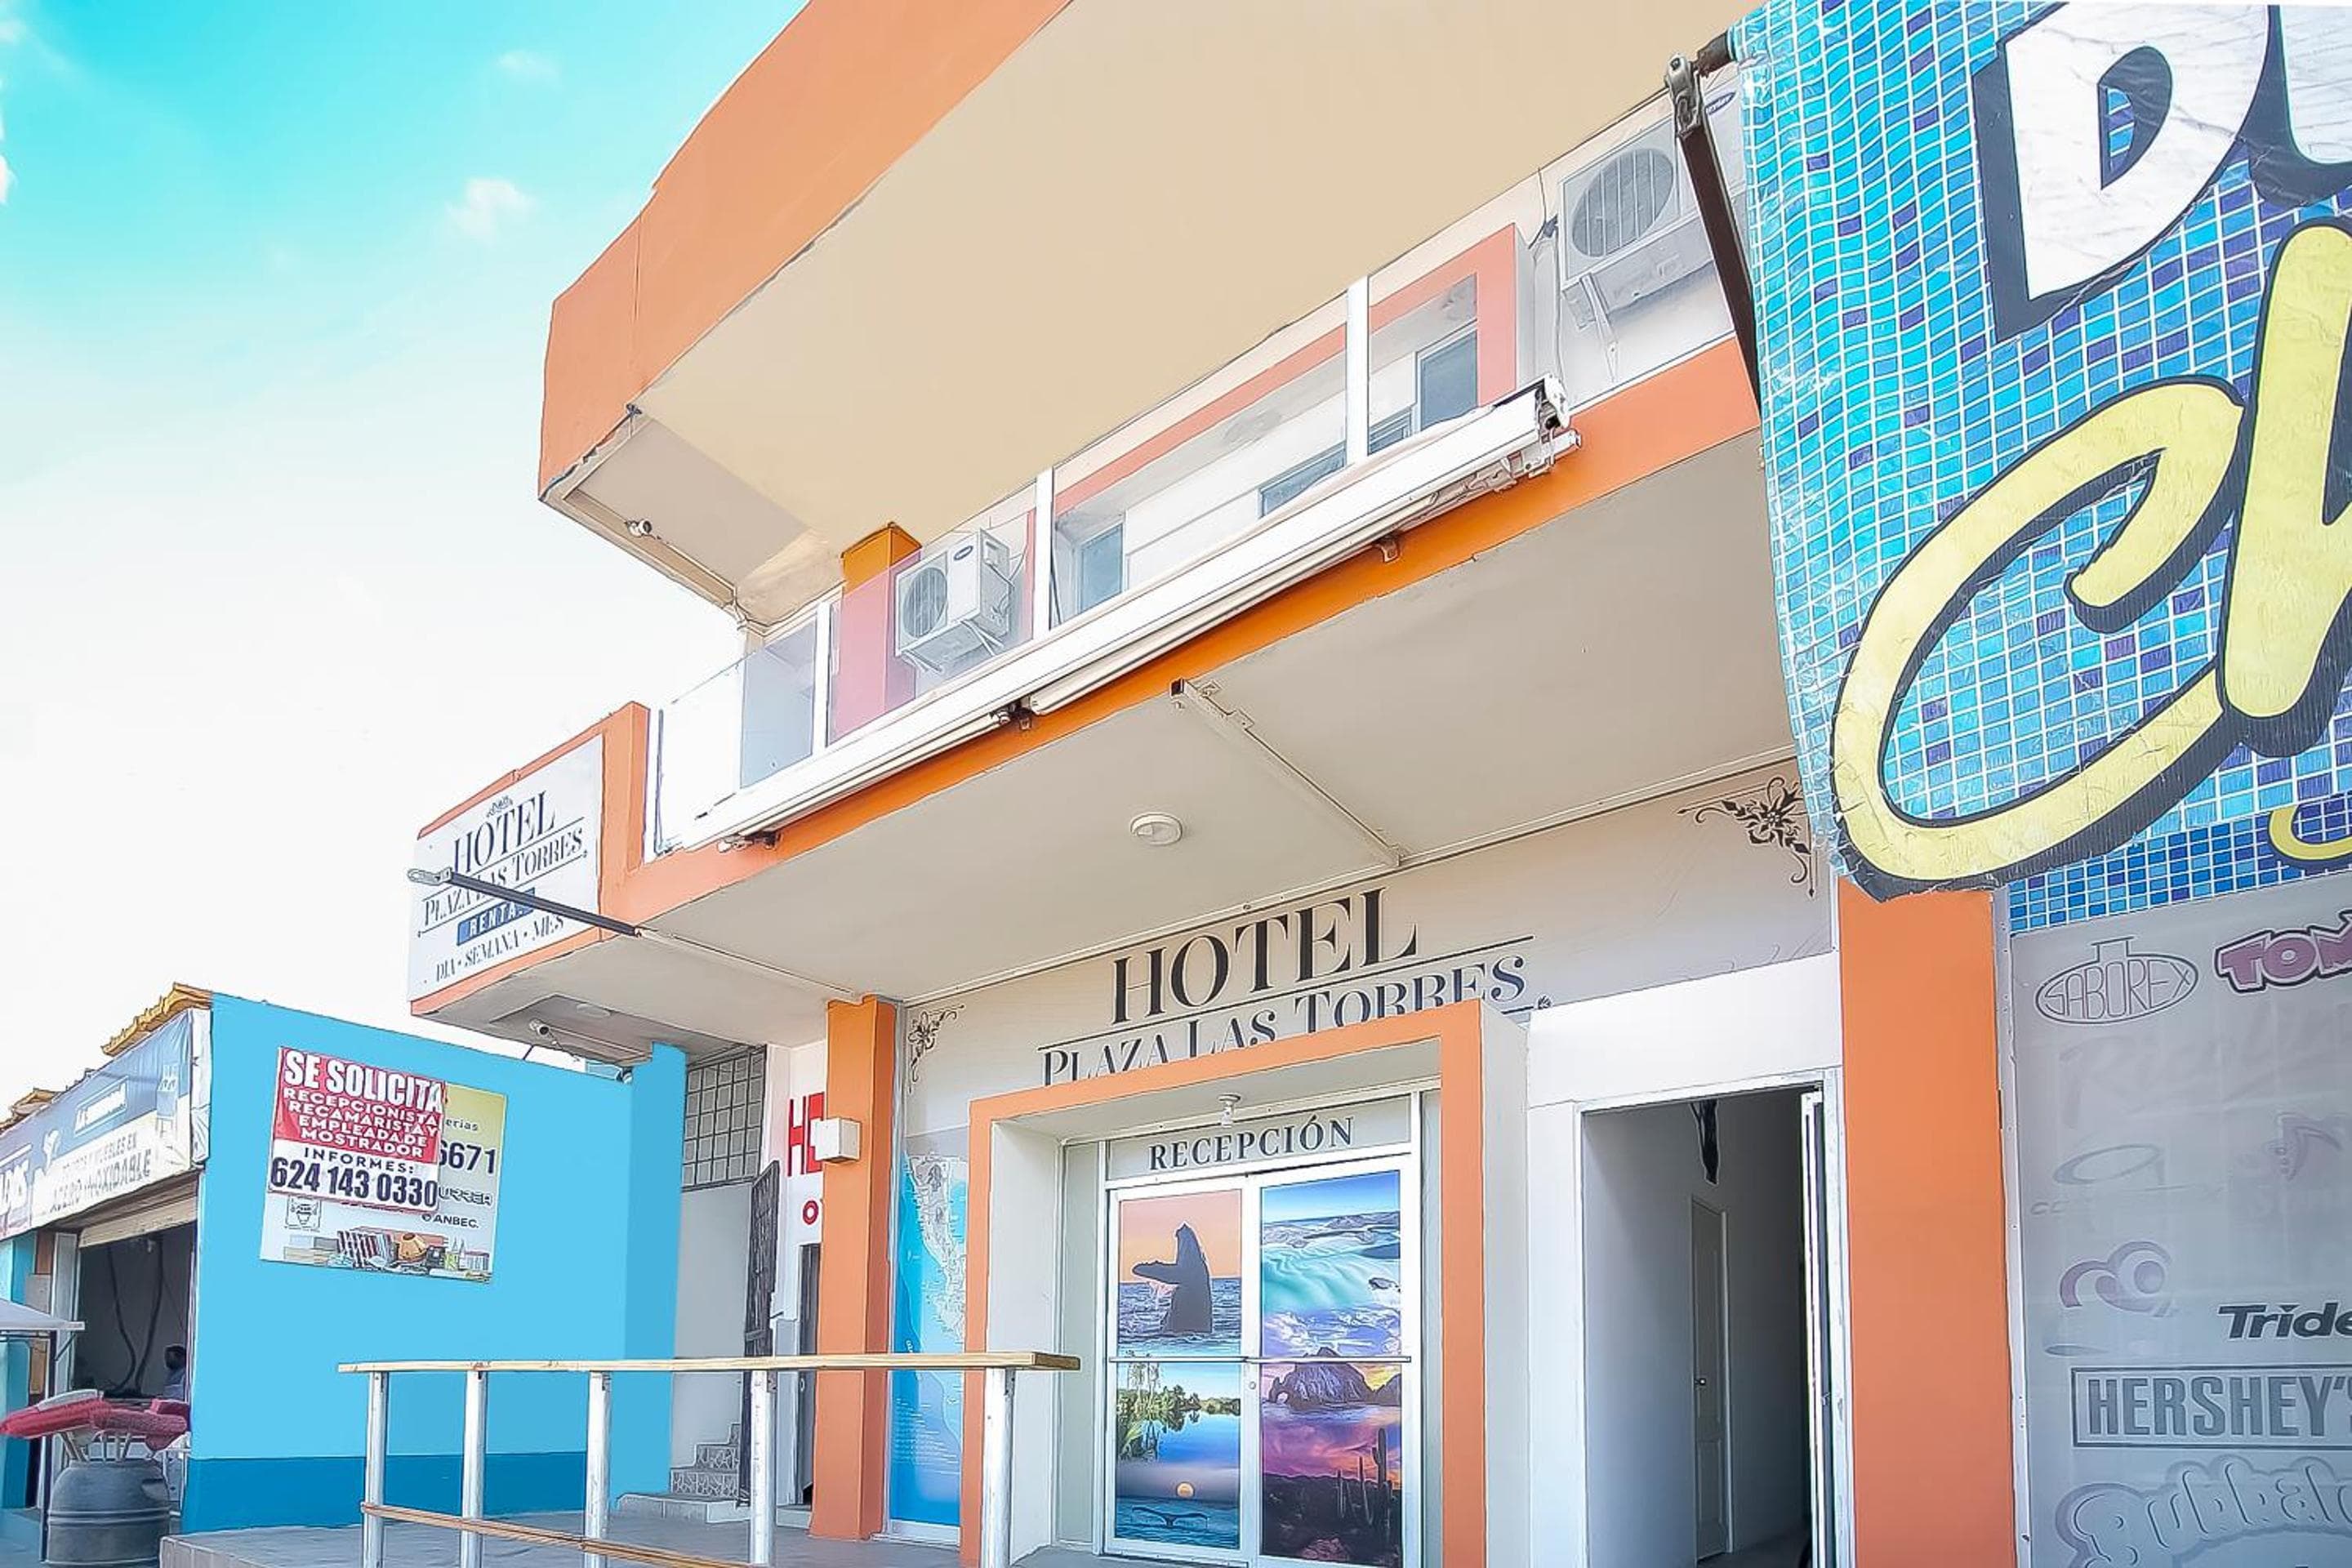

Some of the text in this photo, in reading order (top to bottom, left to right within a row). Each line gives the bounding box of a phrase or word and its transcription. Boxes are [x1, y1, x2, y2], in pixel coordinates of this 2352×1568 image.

[454, 791, 555, 874] HOTEL
[512, 828, 583, 882] TORRES
[533, 915, 564, 940] MES
[1111, 887, 1418, 1025] HOTEL
[2044, 957, 2192, 1021] SABOREX
[1043, 956, 1526, 1087] PLAZA LAS TORRES
[283, 1088, 437, 1126] RECEPCIONISTA
[284, 1050, 443, 1113] SE SOLICITA
[288, 1100, 423, 1136] RECAMARISTA
[299, 1115, 427, 1147] EMPLEADA DE
[301, 1129, 424, 1157] MOSTRADOR
[1148, 1112, 1354, 1171] RECEPCIÓN
[270, 1156, 439, 1208] 624 143 0330
[304, 1147, 414, 1174] INFORMES:
[2087, 1374, 2352, 1437] HERSHEY'
